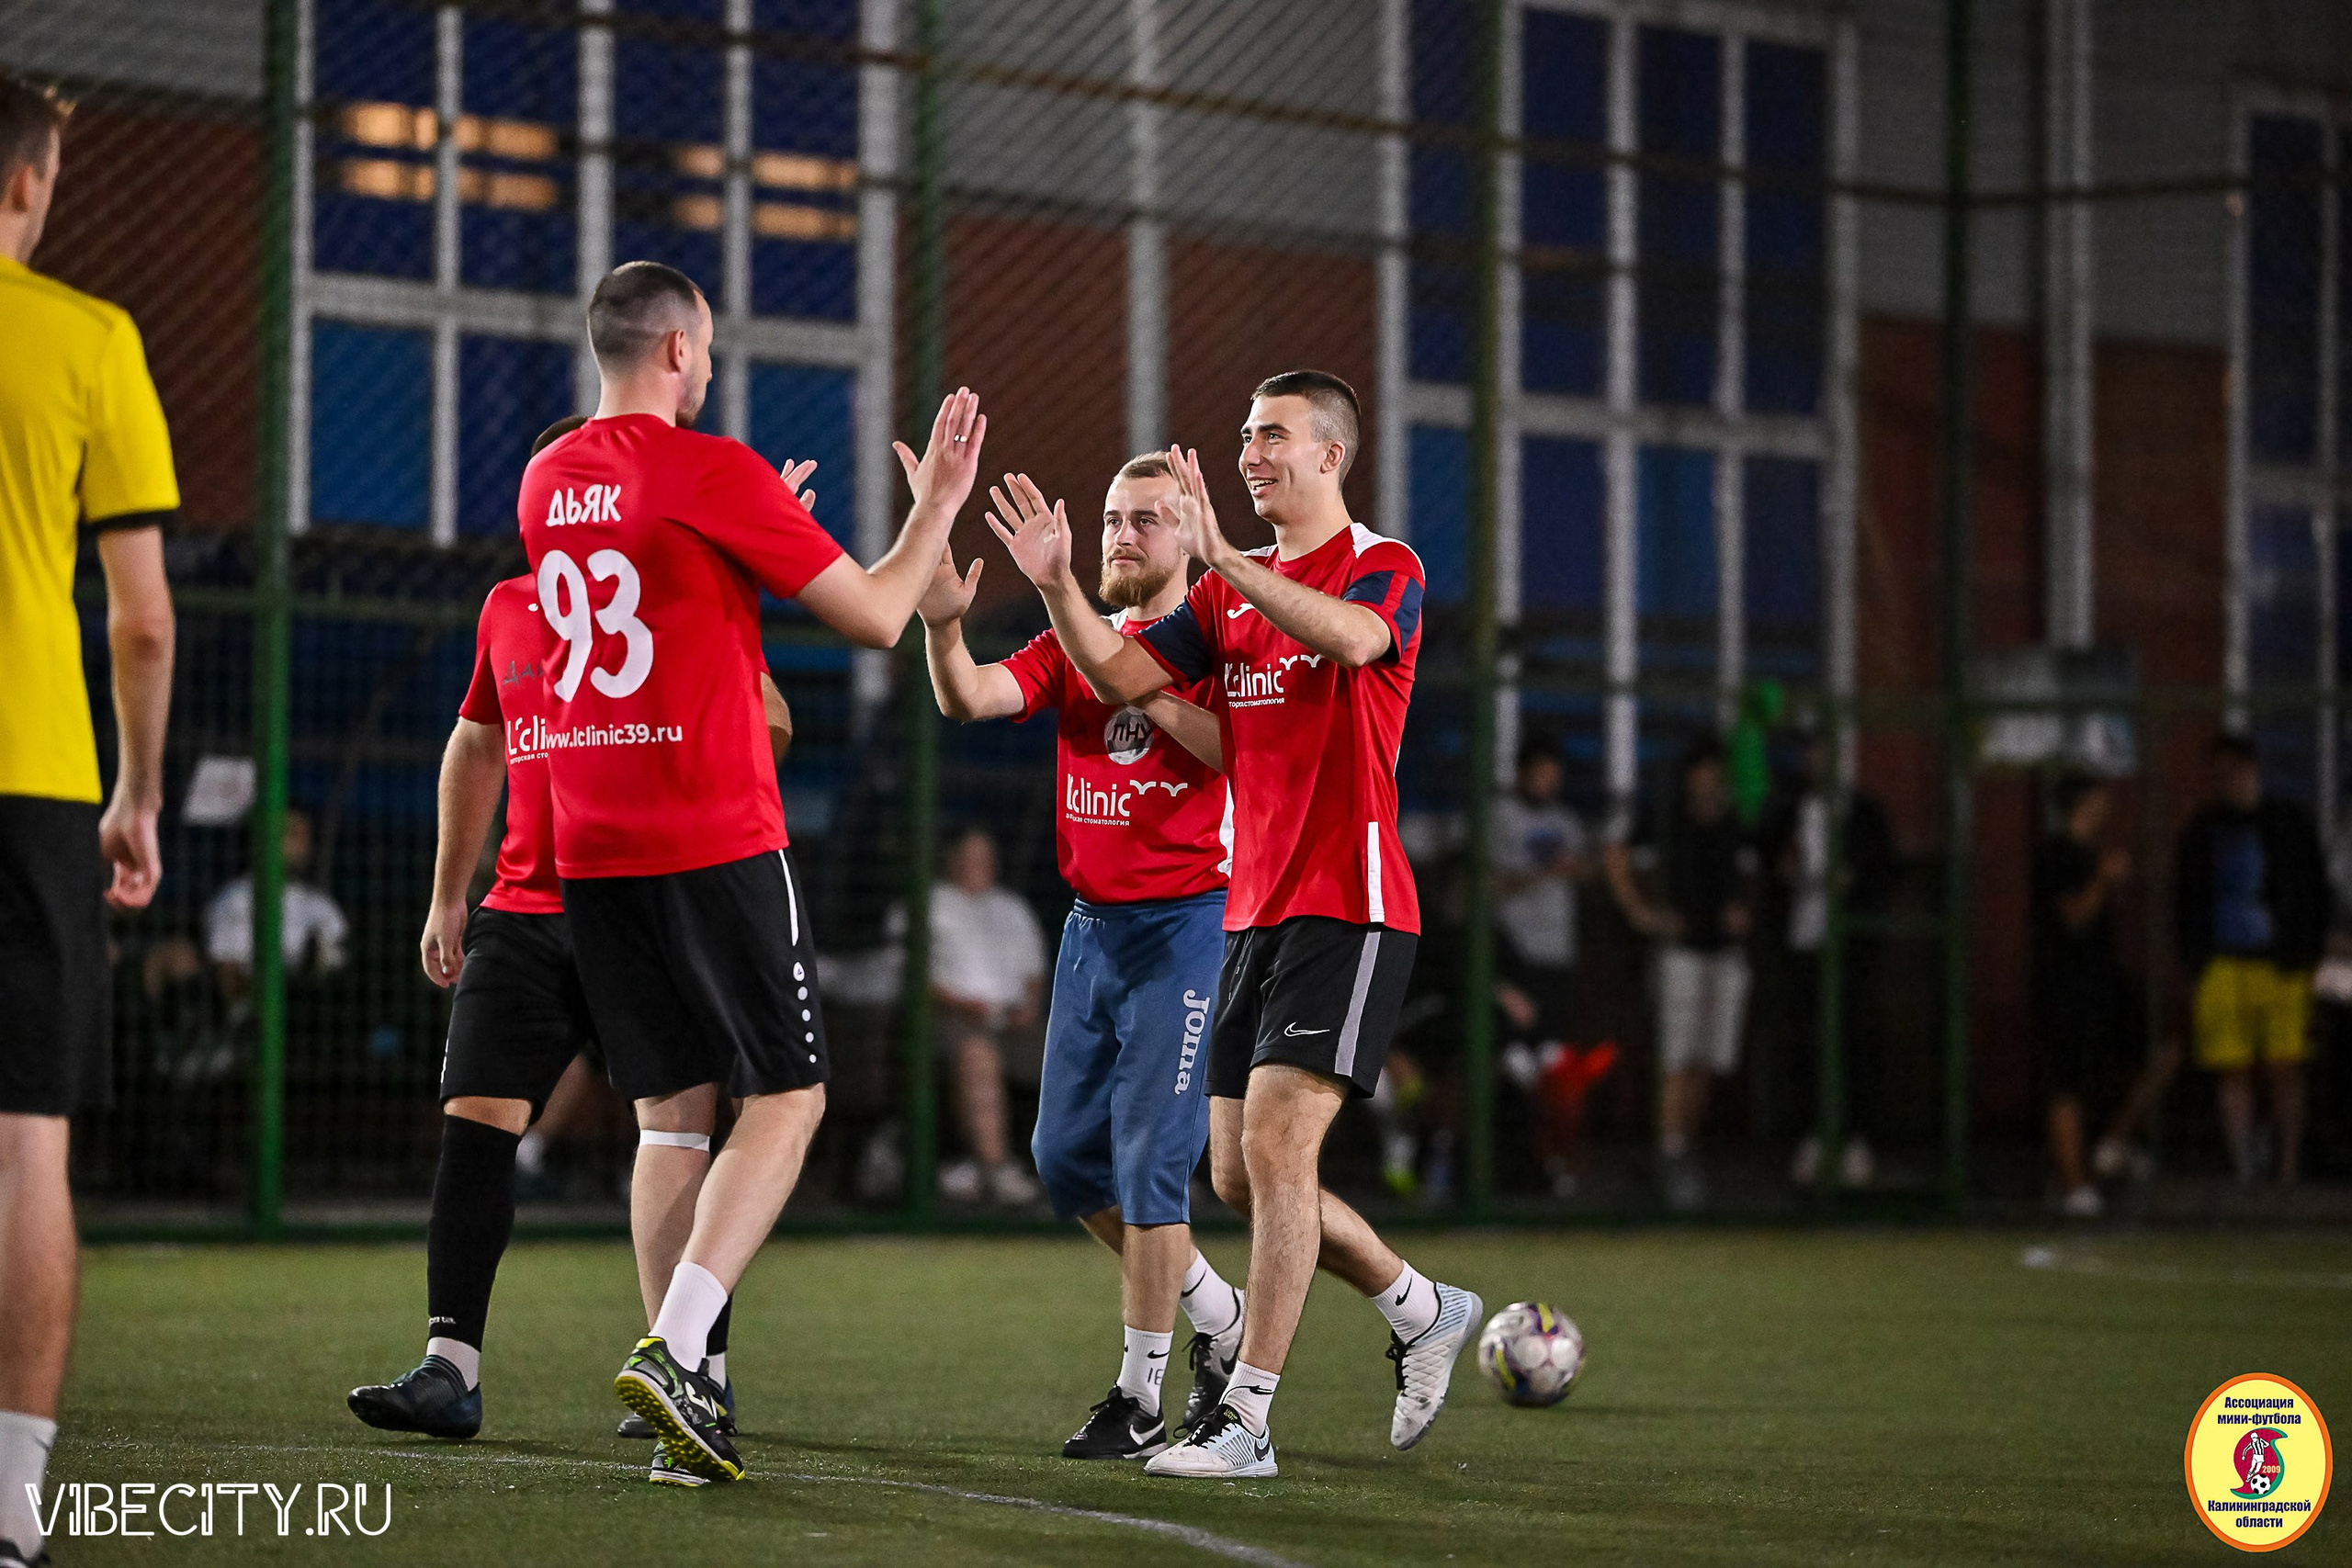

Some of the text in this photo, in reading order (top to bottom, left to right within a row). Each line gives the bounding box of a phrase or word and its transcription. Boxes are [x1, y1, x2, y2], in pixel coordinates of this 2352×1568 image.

[546, 484, 622, 527] ДЬЯК
[537, 549, 654, 703] 93
[1174, 989, 1210, 1095] Joma
